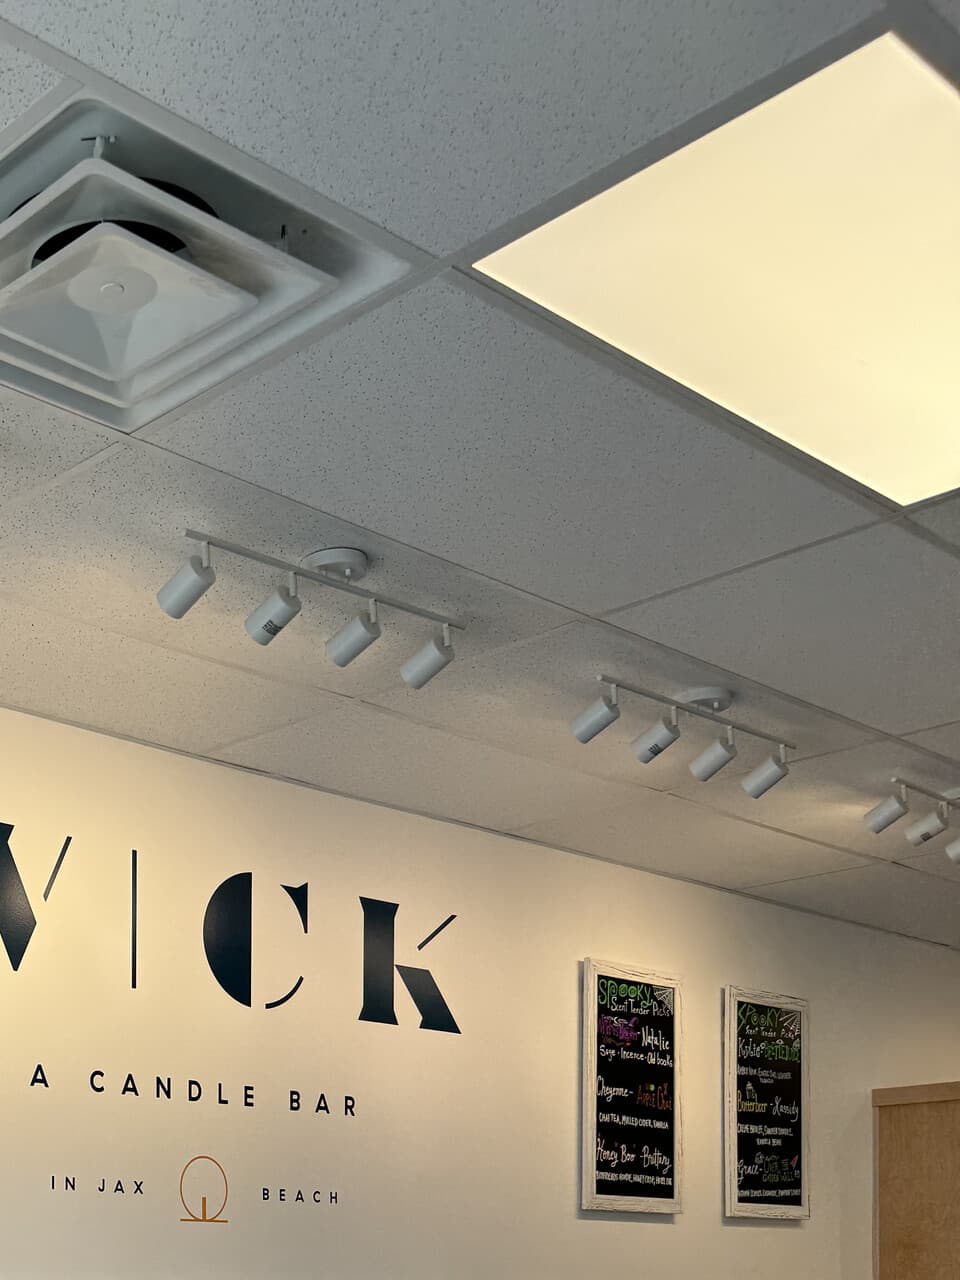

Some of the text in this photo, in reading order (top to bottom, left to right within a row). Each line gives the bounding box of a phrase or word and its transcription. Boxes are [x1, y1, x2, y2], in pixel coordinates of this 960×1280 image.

[29, 1063, 357, 1117] A CANDLE BAR
[50, 1175, 340, 1205] IN JAX BEACH
